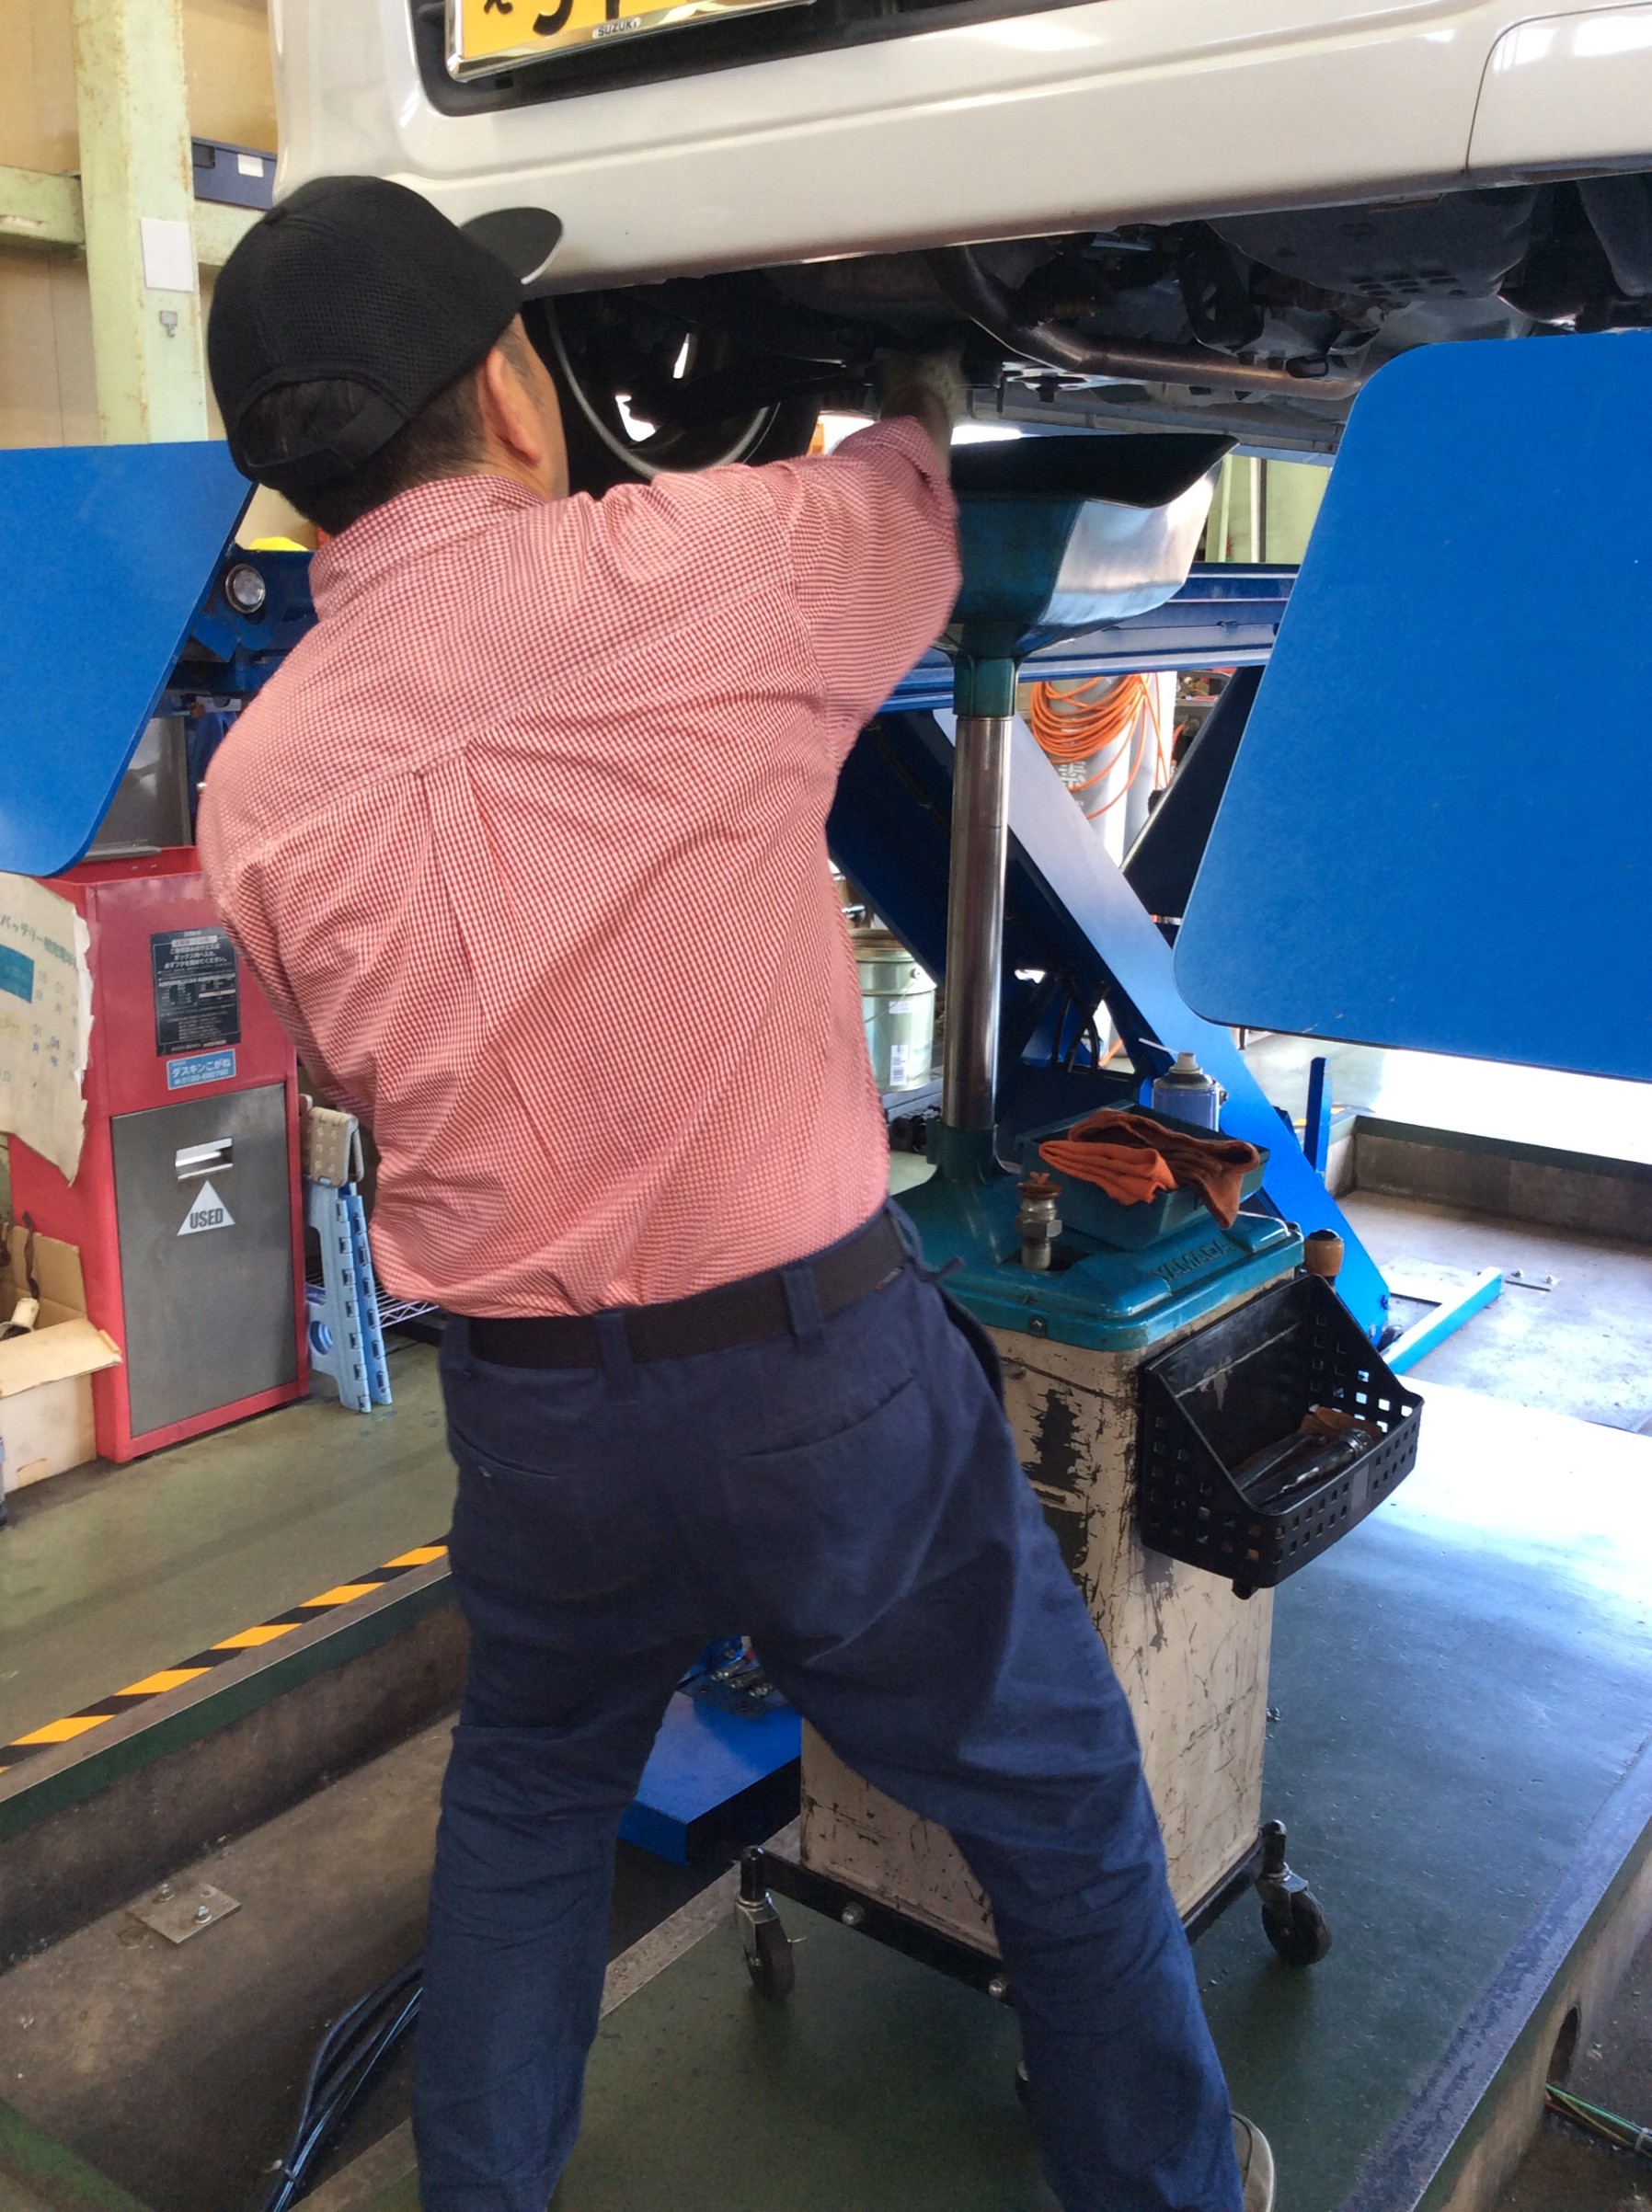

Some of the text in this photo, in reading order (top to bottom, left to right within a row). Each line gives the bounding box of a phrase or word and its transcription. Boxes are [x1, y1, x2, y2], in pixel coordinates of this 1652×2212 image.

[597, 20, 638, 37] SUZUKI
[171, 1058, 232, 1079] ダスキンこがね
[189, 1208, 224, 1230] USED
